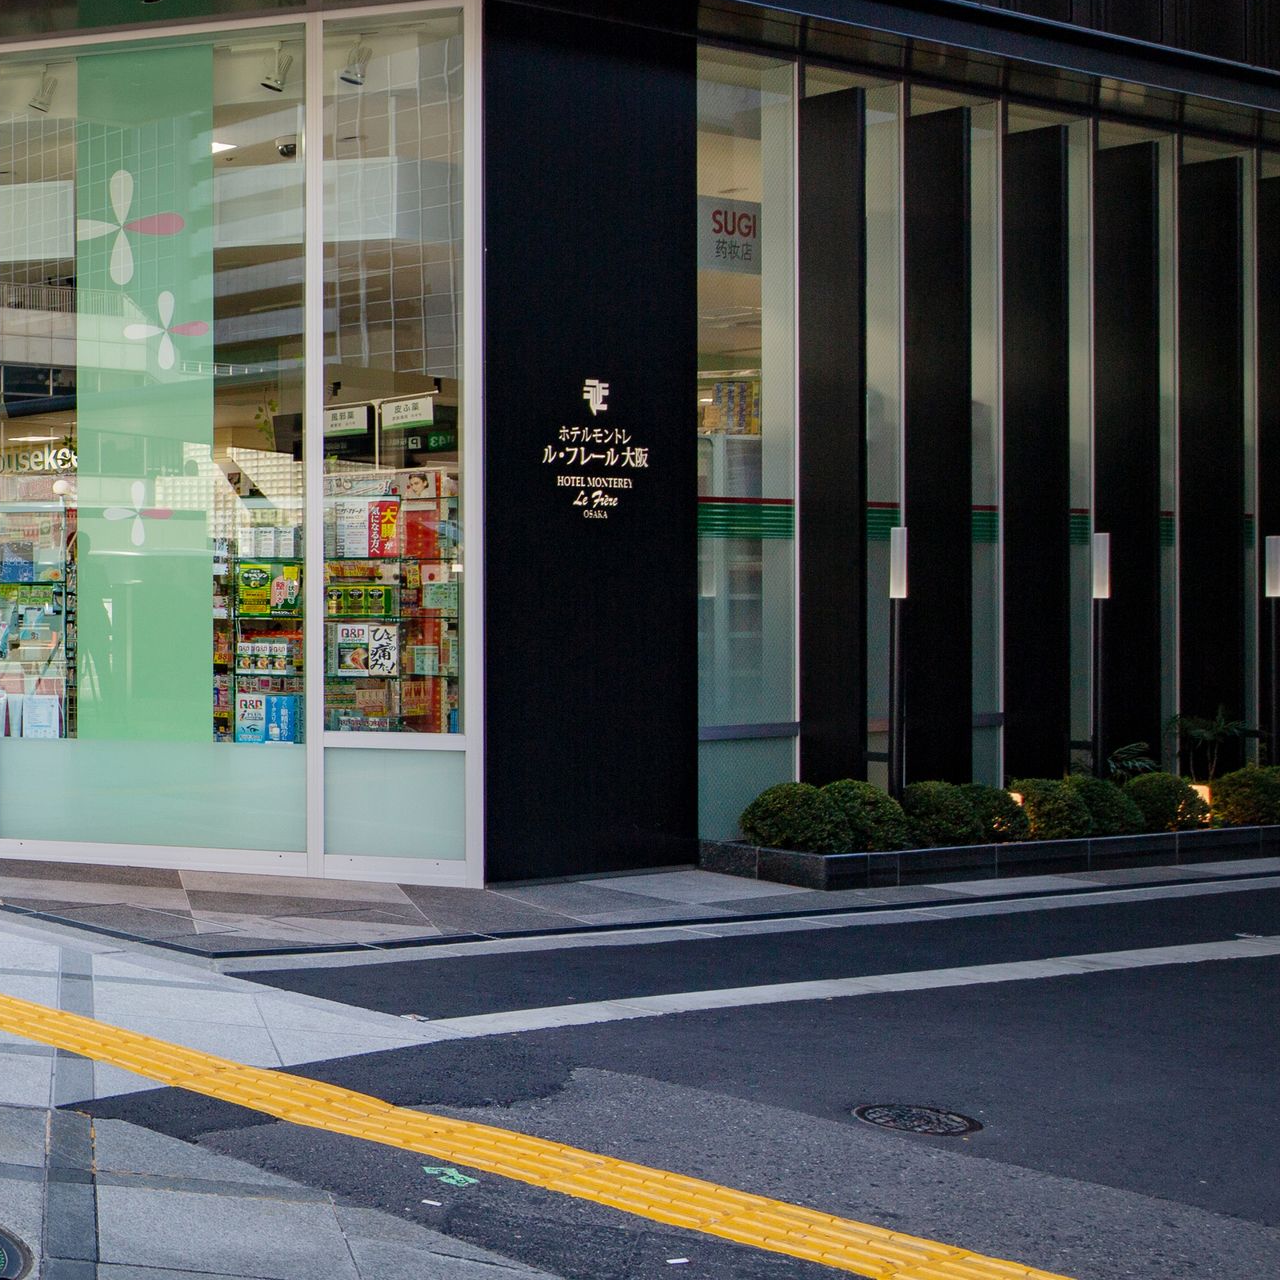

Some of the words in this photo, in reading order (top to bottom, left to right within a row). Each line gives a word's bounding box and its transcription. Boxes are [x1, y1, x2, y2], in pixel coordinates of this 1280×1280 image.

[711, 209, 756, 239] SUGI
[558, 425, 632, 444] ホテルモントレ
[557, 475, 586, 487] HOTEL
[587, 476, 633, 489] MONTEREY
[572, 490, 588, 506] Le
[583, 510, 608, 519] OSAKA
